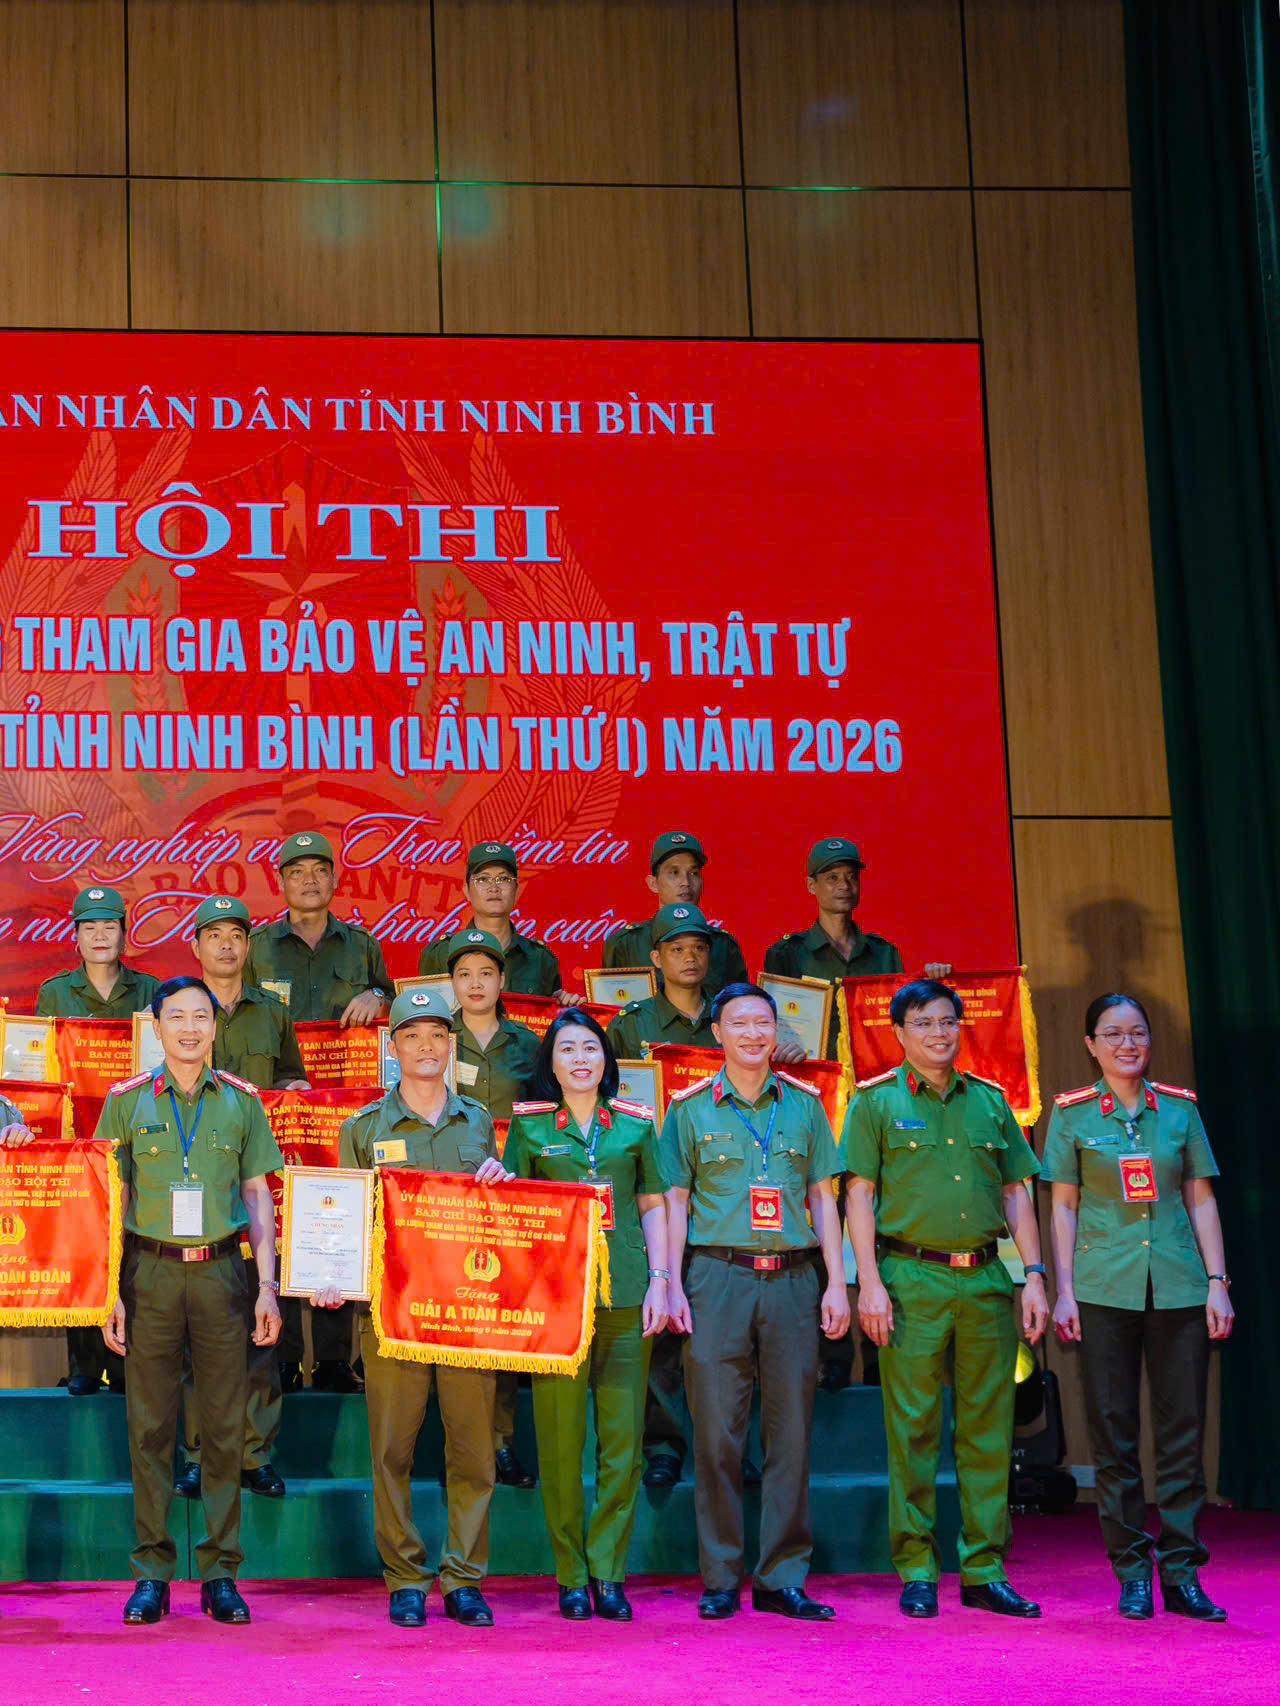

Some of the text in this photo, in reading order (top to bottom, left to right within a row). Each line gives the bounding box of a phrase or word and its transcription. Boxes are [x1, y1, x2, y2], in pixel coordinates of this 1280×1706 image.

[57, 384, 197, 430] NHÂN
[212, 385, 313, 431] DÂN
[324, 388, 446, 433] TỈNH
[460, 398, 582, 435] NINH
[596, 391, 715, 437] BÌNH
[27, 481, 562, 578] HỘI THI
[13, 616, 153, 674] THAM
[165, 616, 244, 674] GIA
[258, 600, 357, 675] BẢO
[365, 607, 427, 687] VỆ
[438, 619, 507, 676] AN
[517, 619, 652, 684] NINH,
[660, 610, 779, 689] TRẬT
[787, 616, 853, 690] TỰ
[122, 713, 245, 771] NINH
[256, 702, 376, 772] BÌNH
[387, 695, 502, 778] (LẦN
[509, 704, 609, 774] THỨ
[615, 716, 650, 779] I)
[661, 705, 776, 774] NĂM
[785, 717, 904, 775] 2026
[90, 820, 241, 884] nghiệp
[342, 812, 461, 870] Trọn
[572, 828, 630, 864] tin
[370, 900, 470, 944] bình
[303, 1041, 321, 1050] BAN
[303, 1049, 375, 1062] BAN CHỈ ĐẠO
[415, 1207, 440, 1218] BAN
[523, 1217, 546, 1229] THI
[512, 1203, 537, 1215] NINH
[409, 1298, 546, 1326] GIẢI A TOÀN ĐOÀN
[455, 1285, 501, 1303] Tặng
